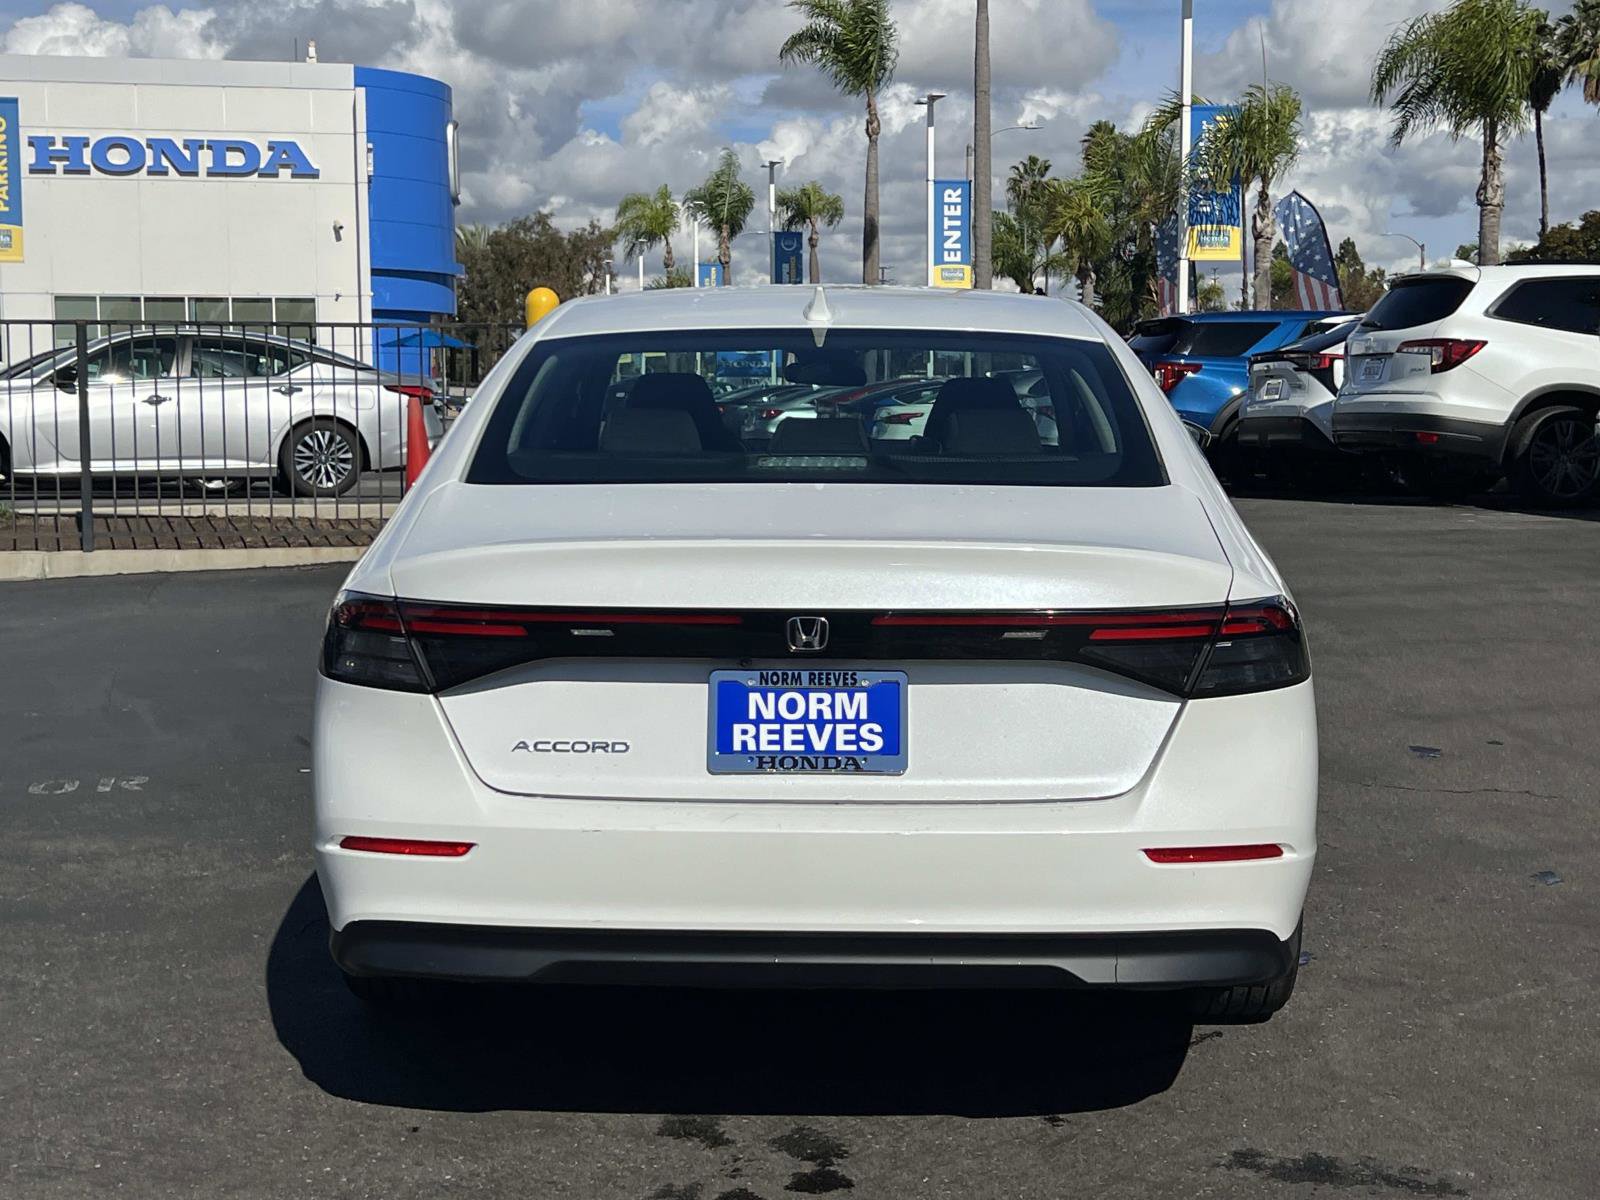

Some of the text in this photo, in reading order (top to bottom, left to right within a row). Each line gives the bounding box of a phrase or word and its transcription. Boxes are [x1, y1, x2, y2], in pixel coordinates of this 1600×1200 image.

[28, 135, 320, 179] HONDA
[943, 187, 962, 262] ENTER
[759, 672, 858, 687] NORM REEVES
[748, 692, 867, 720] NORM
[511, 741, 630, 754] ACCORD
[732, 723, 884, 752] REEVES
[756, 756, 864, 771] HONDA
